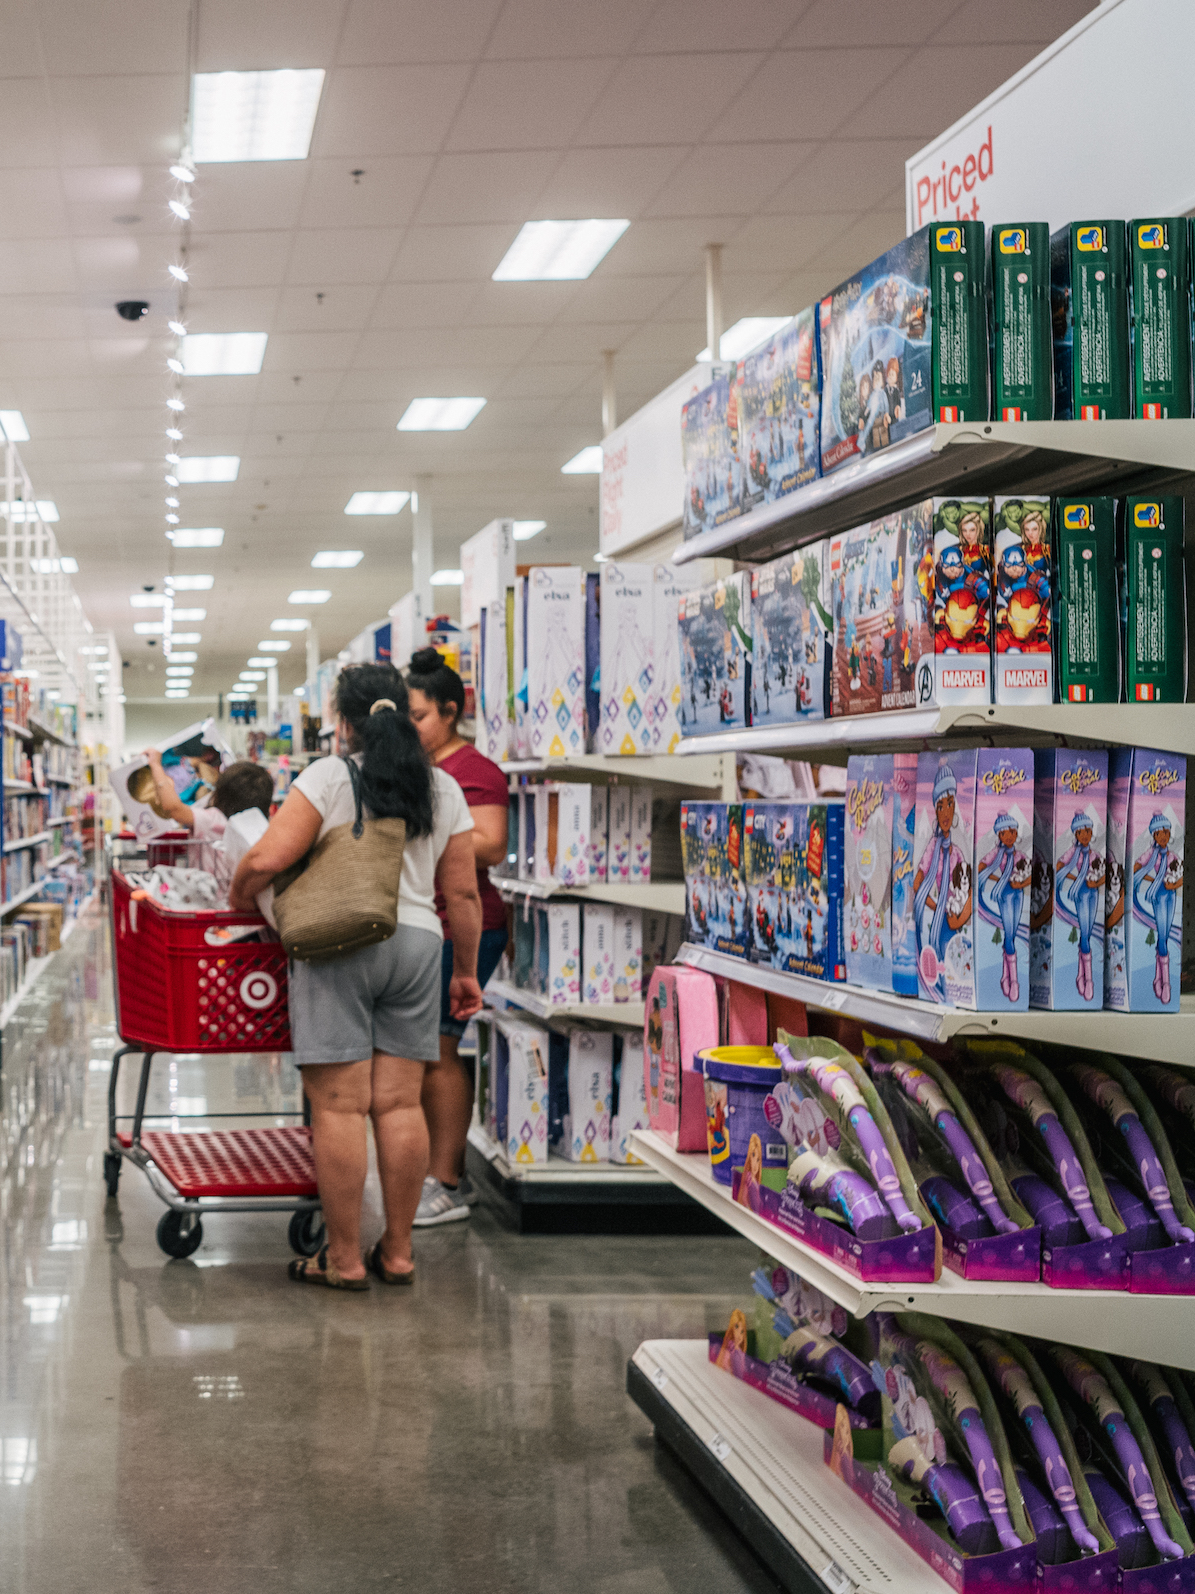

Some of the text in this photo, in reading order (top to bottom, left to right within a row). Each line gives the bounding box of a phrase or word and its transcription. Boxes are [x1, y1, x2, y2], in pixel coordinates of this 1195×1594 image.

[917, 124, 993, 227] Priced
[911, 370, 923, 390] 24
[944, 672, 985, 686] MARVEL
[1005, 671, 1047, 685] MARVEL
[983, 768, 1017, 786] Color
[1061, 769, 1096, 787] Color
[1139, 769, 1174, 787] Color
[848, 777, 878, 814] Color
